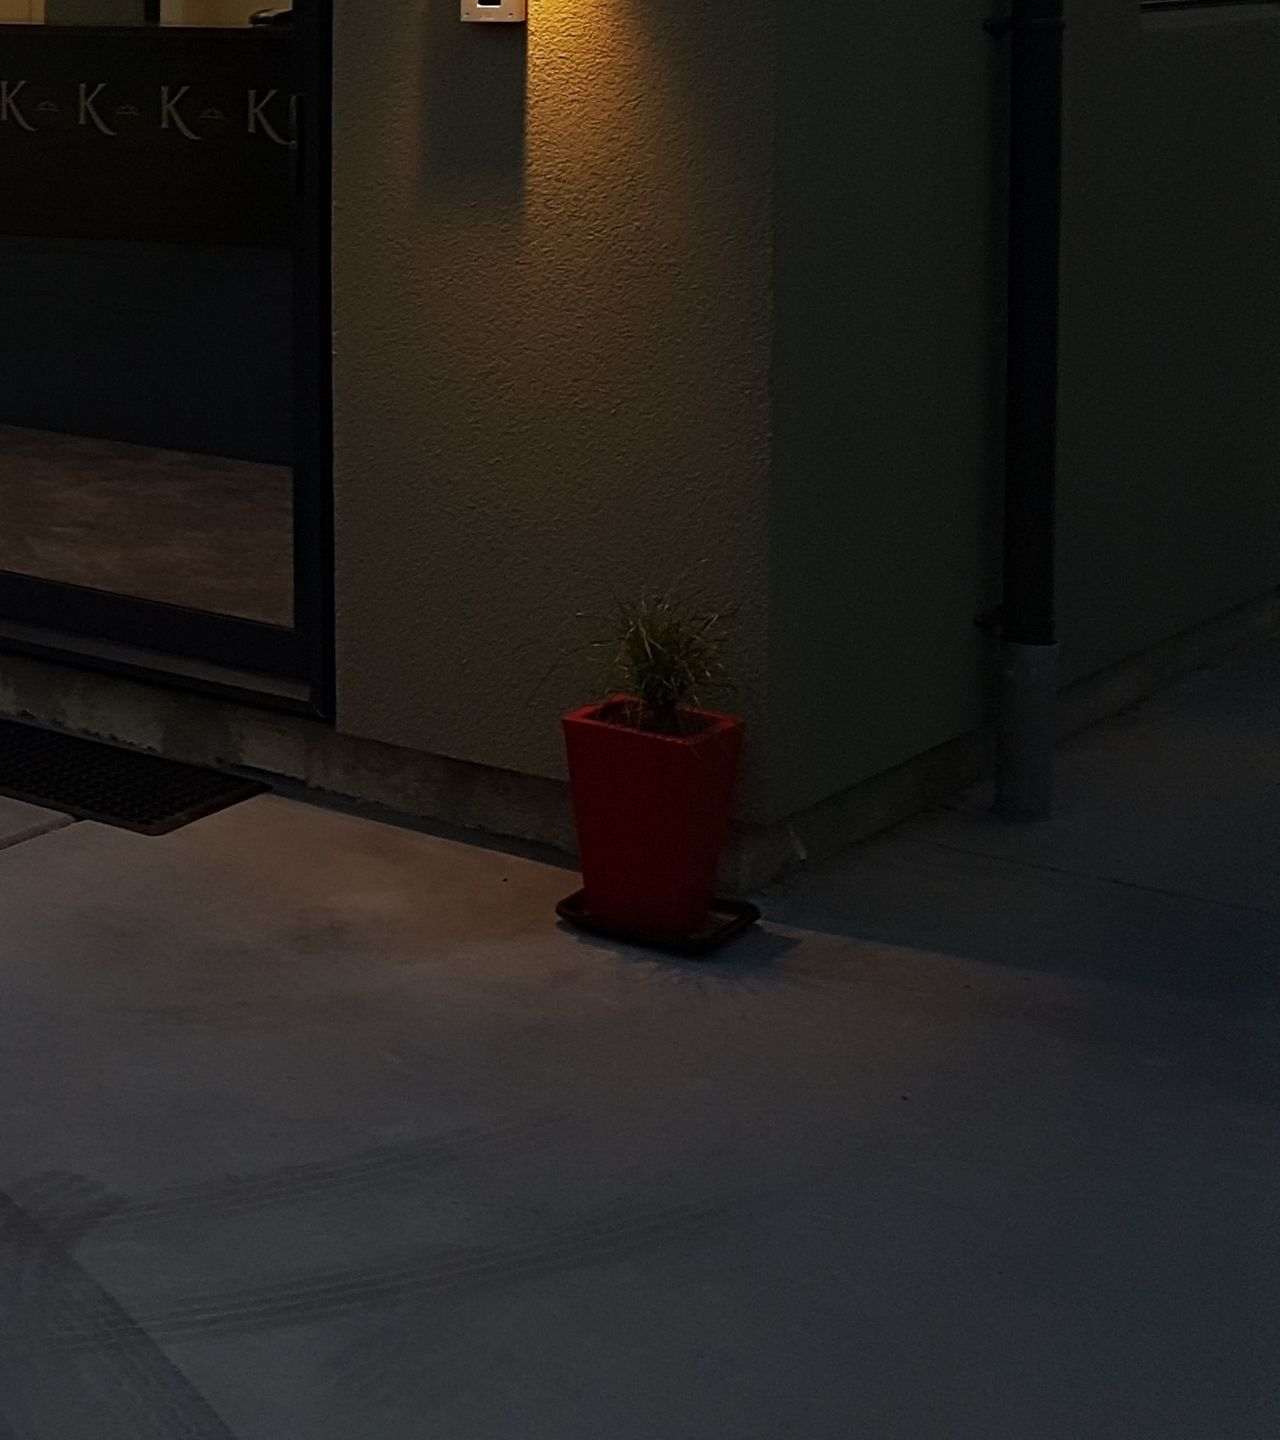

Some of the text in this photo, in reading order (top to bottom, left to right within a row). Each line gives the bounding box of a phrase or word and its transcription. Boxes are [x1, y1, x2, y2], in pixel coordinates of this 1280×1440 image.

[0, 79, 39, 132] K
[78, 81, 118, 136] K
[160, 85, 203, 141] K
[247, 89, 291, 145] K
